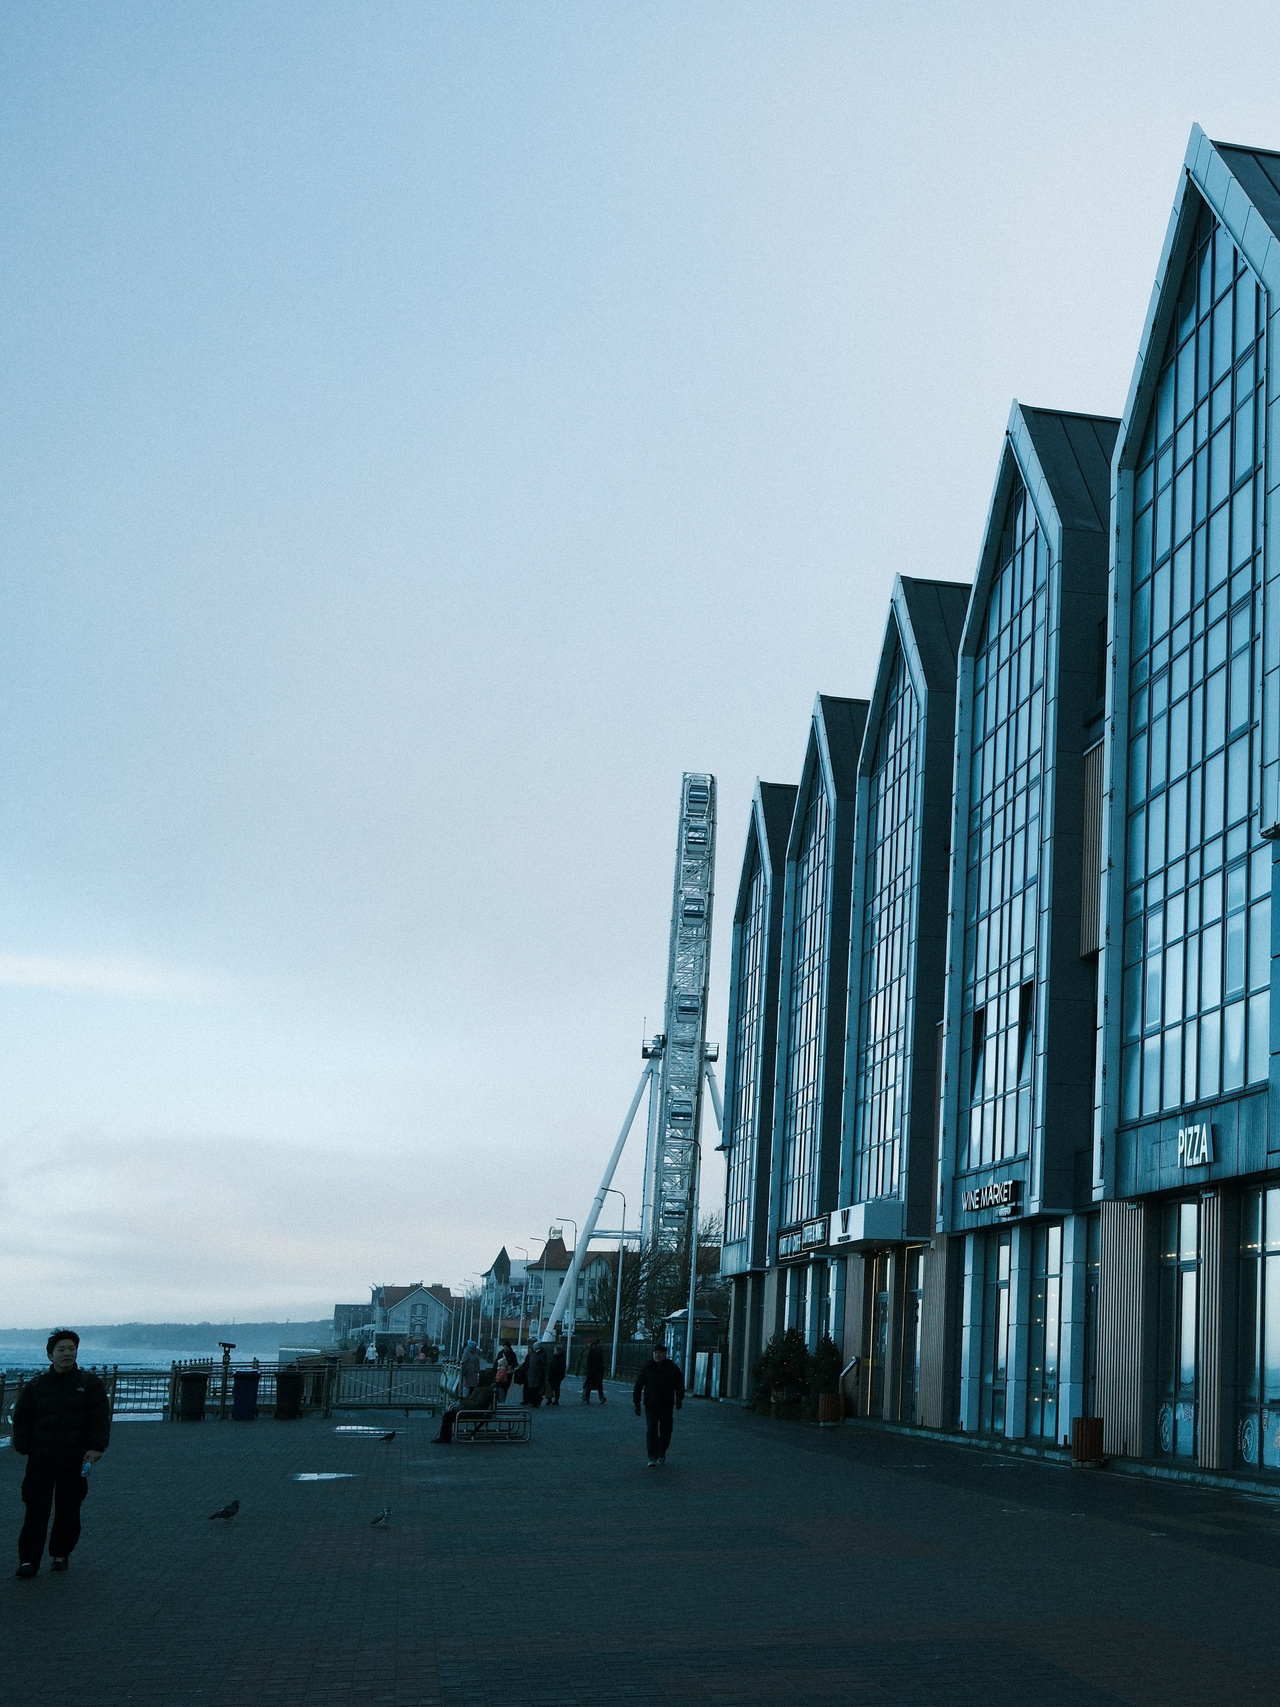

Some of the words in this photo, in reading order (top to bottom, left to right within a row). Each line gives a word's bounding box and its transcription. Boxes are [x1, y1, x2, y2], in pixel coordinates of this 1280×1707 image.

[1178, 1122, 1209, 1169] PIZZA
[962, 1188, 980, 1212] WINE
[980, 1180, 1013, 1208] MARKET
